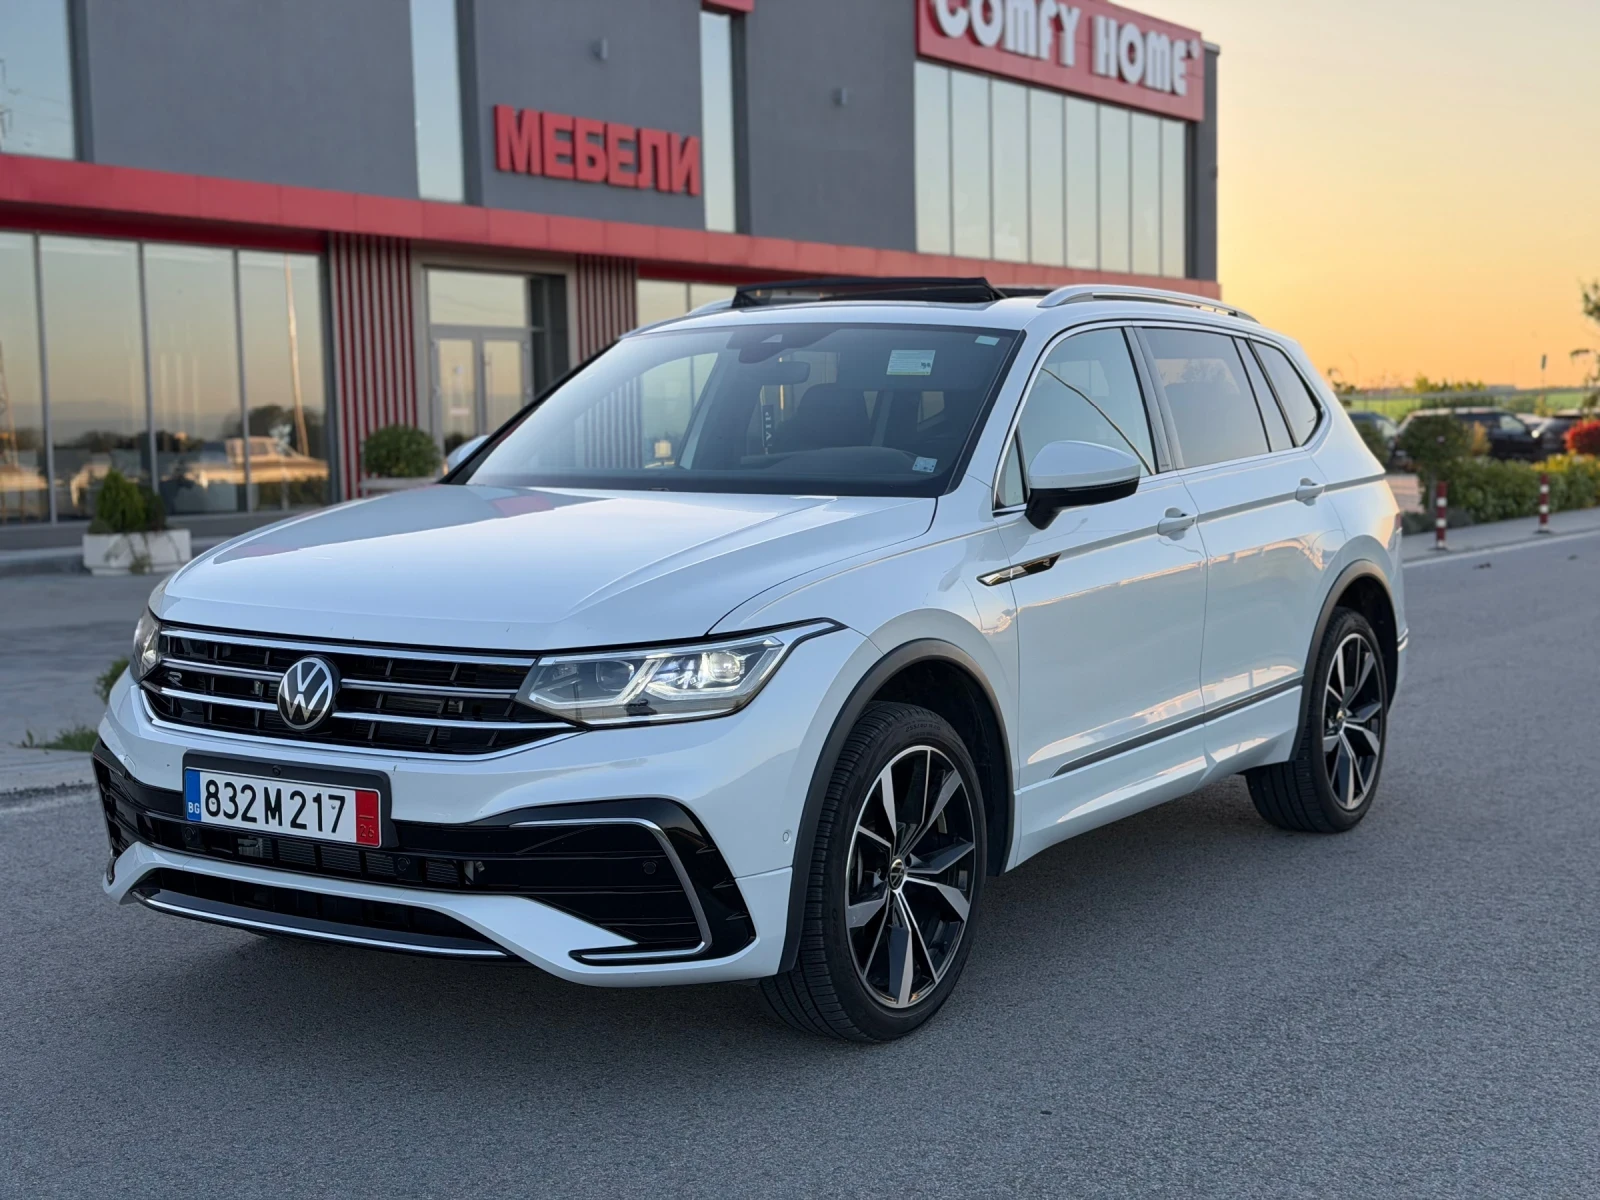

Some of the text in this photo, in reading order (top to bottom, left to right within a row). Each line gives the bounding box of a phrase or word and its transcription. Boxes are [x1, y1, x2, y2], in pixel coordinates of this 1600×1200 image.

[493, 103, 700, 196] МЕБЕЛИ
[188, 801, 200, 814] BG
[359, 823, 375, 839] 26
